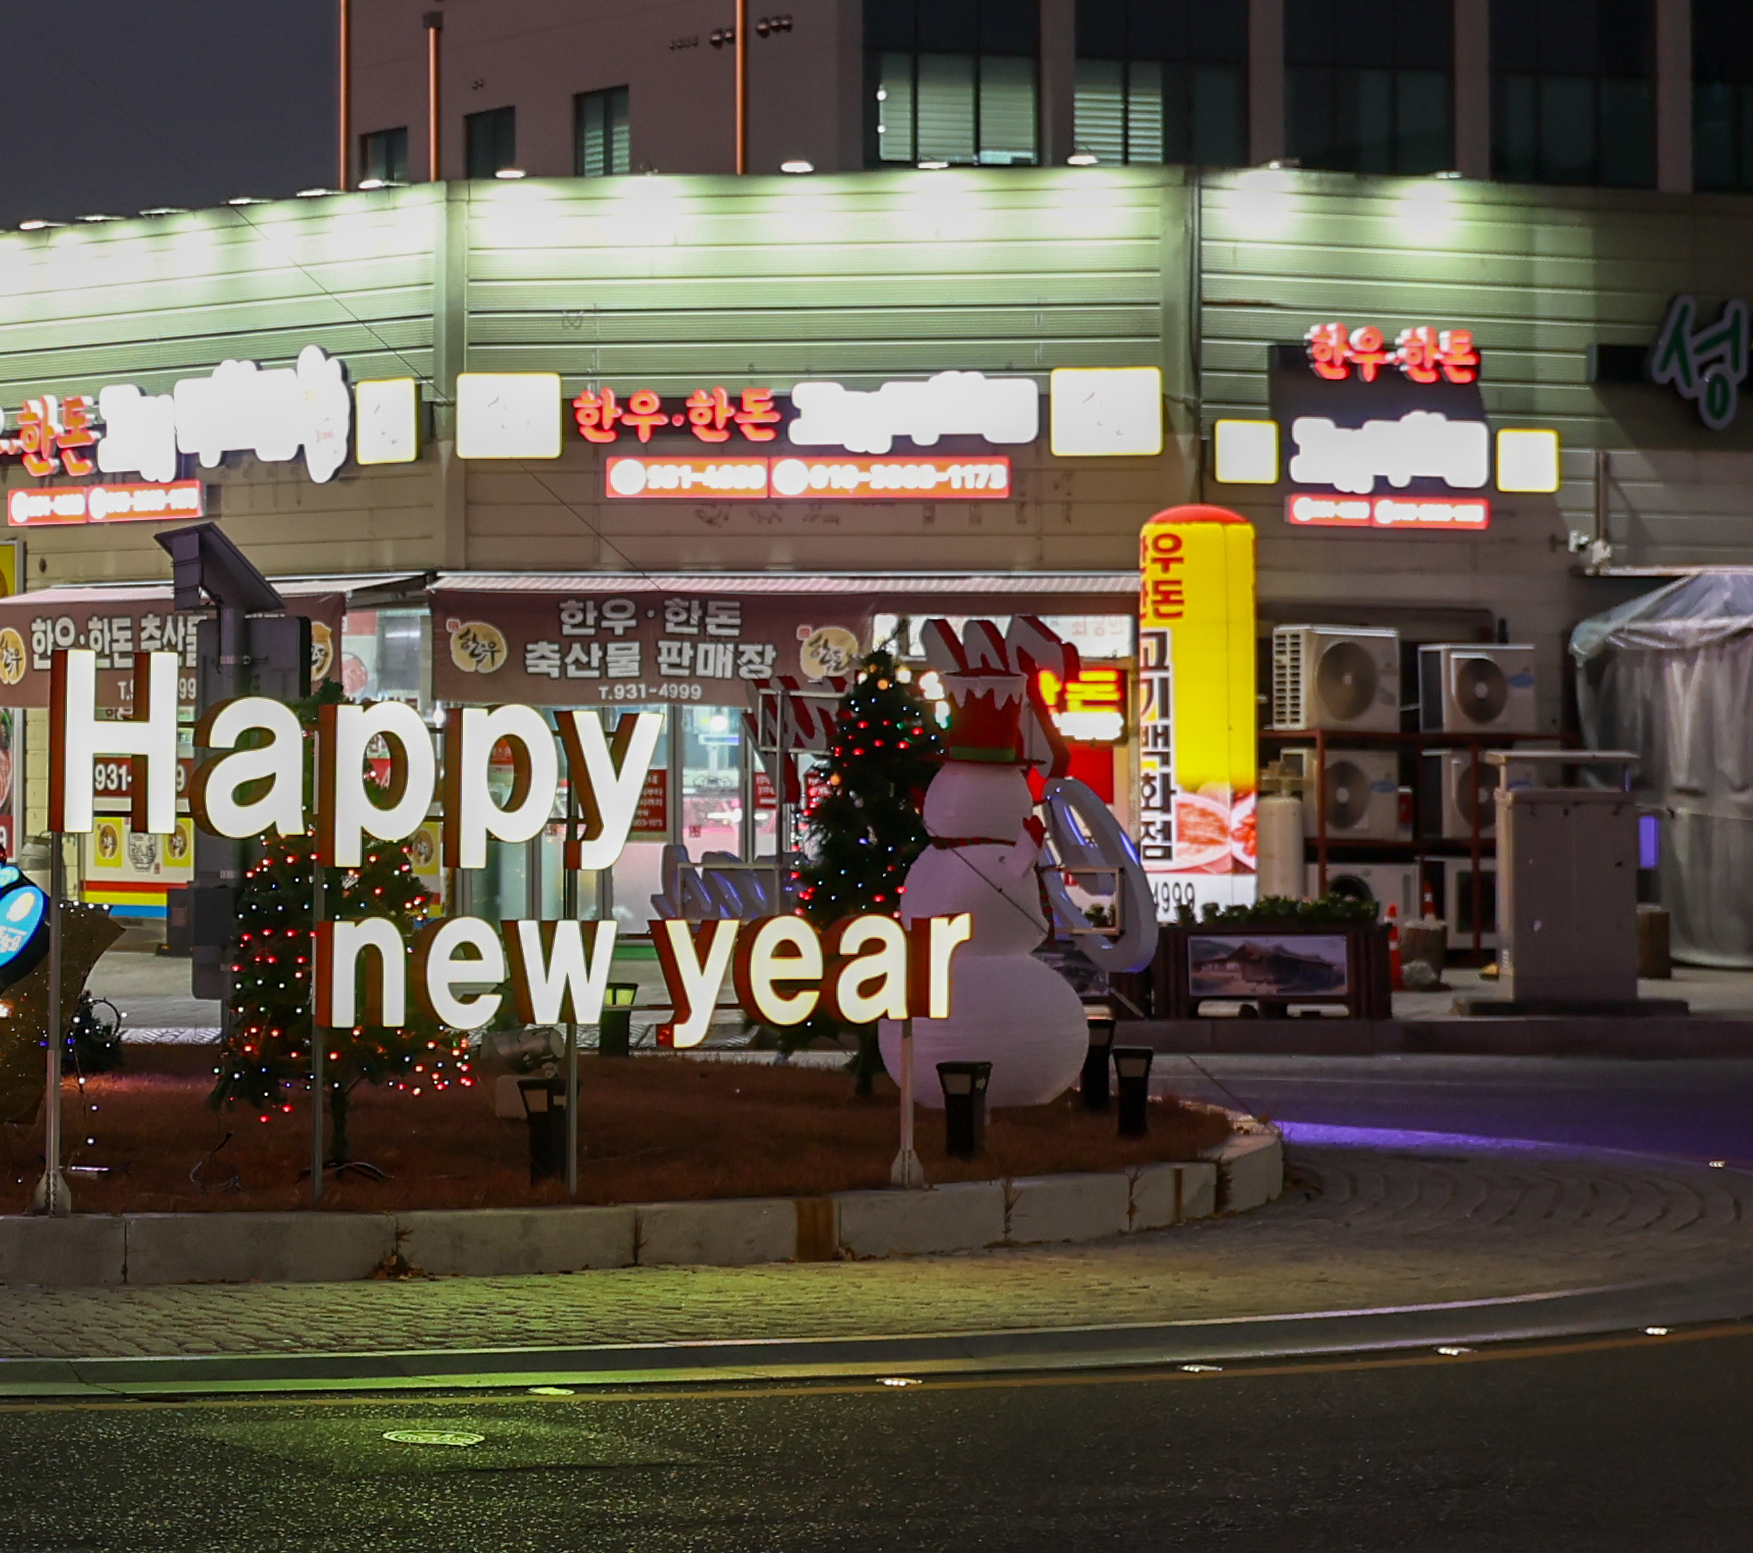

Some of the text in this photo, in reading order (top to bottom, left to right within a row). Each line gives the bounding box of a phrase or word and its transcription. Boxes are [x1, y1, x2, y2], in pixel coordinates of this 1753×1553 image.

[524, 639, 777, 680] 축산물 판매장
[599, 682, 702, 701] T.931-4999
[59, 649, 663, 870] Happy
[329, 913, 973, 1048] new year
